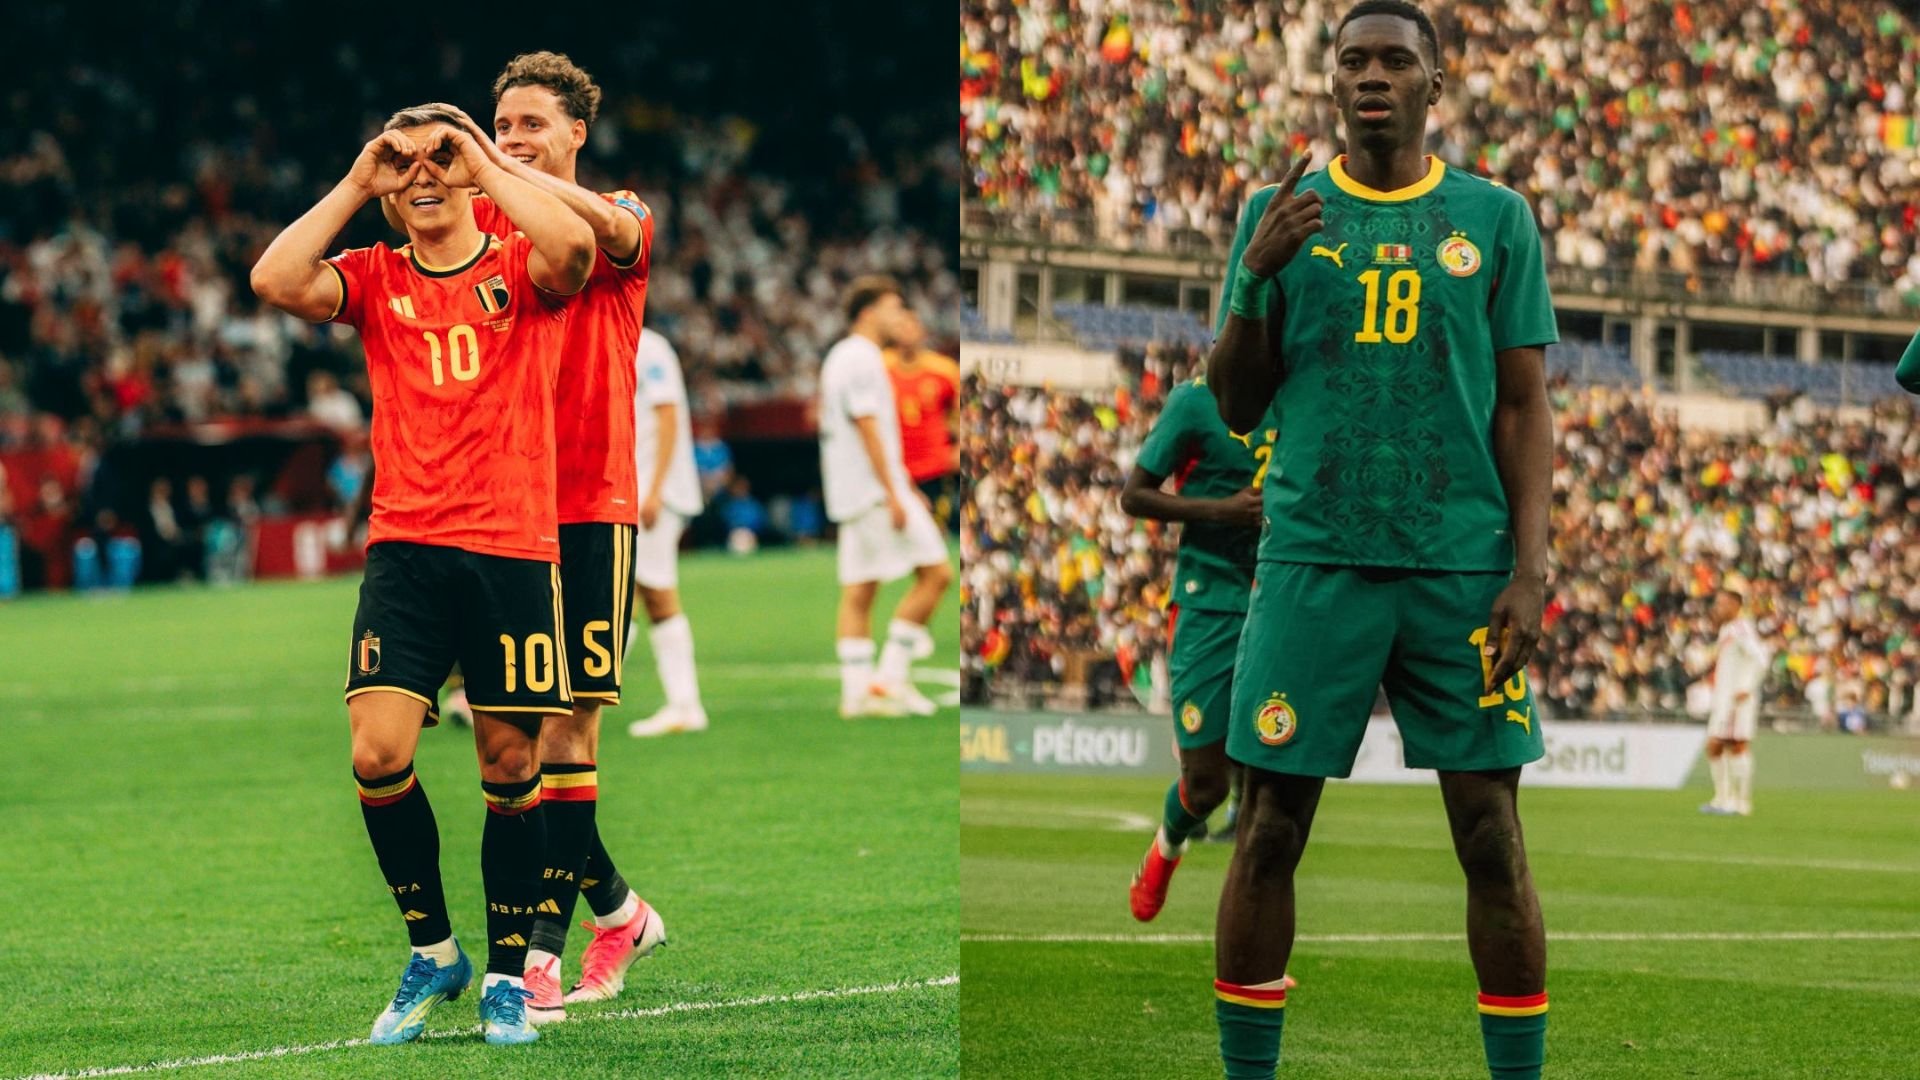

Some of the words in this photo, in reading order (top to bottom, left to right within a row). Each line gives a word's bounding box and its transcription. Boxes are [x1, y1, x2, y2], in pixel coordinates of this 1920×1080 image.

[1355, 269, 1421, 343] 18
[423, 324, 480, 386] 10
[500, 633, 554, 692] 10
[583, 620, 611, 677] 5
[1033, 719, 1147, 766] PÉROU
[1537, 736, 1626, 773] Send
